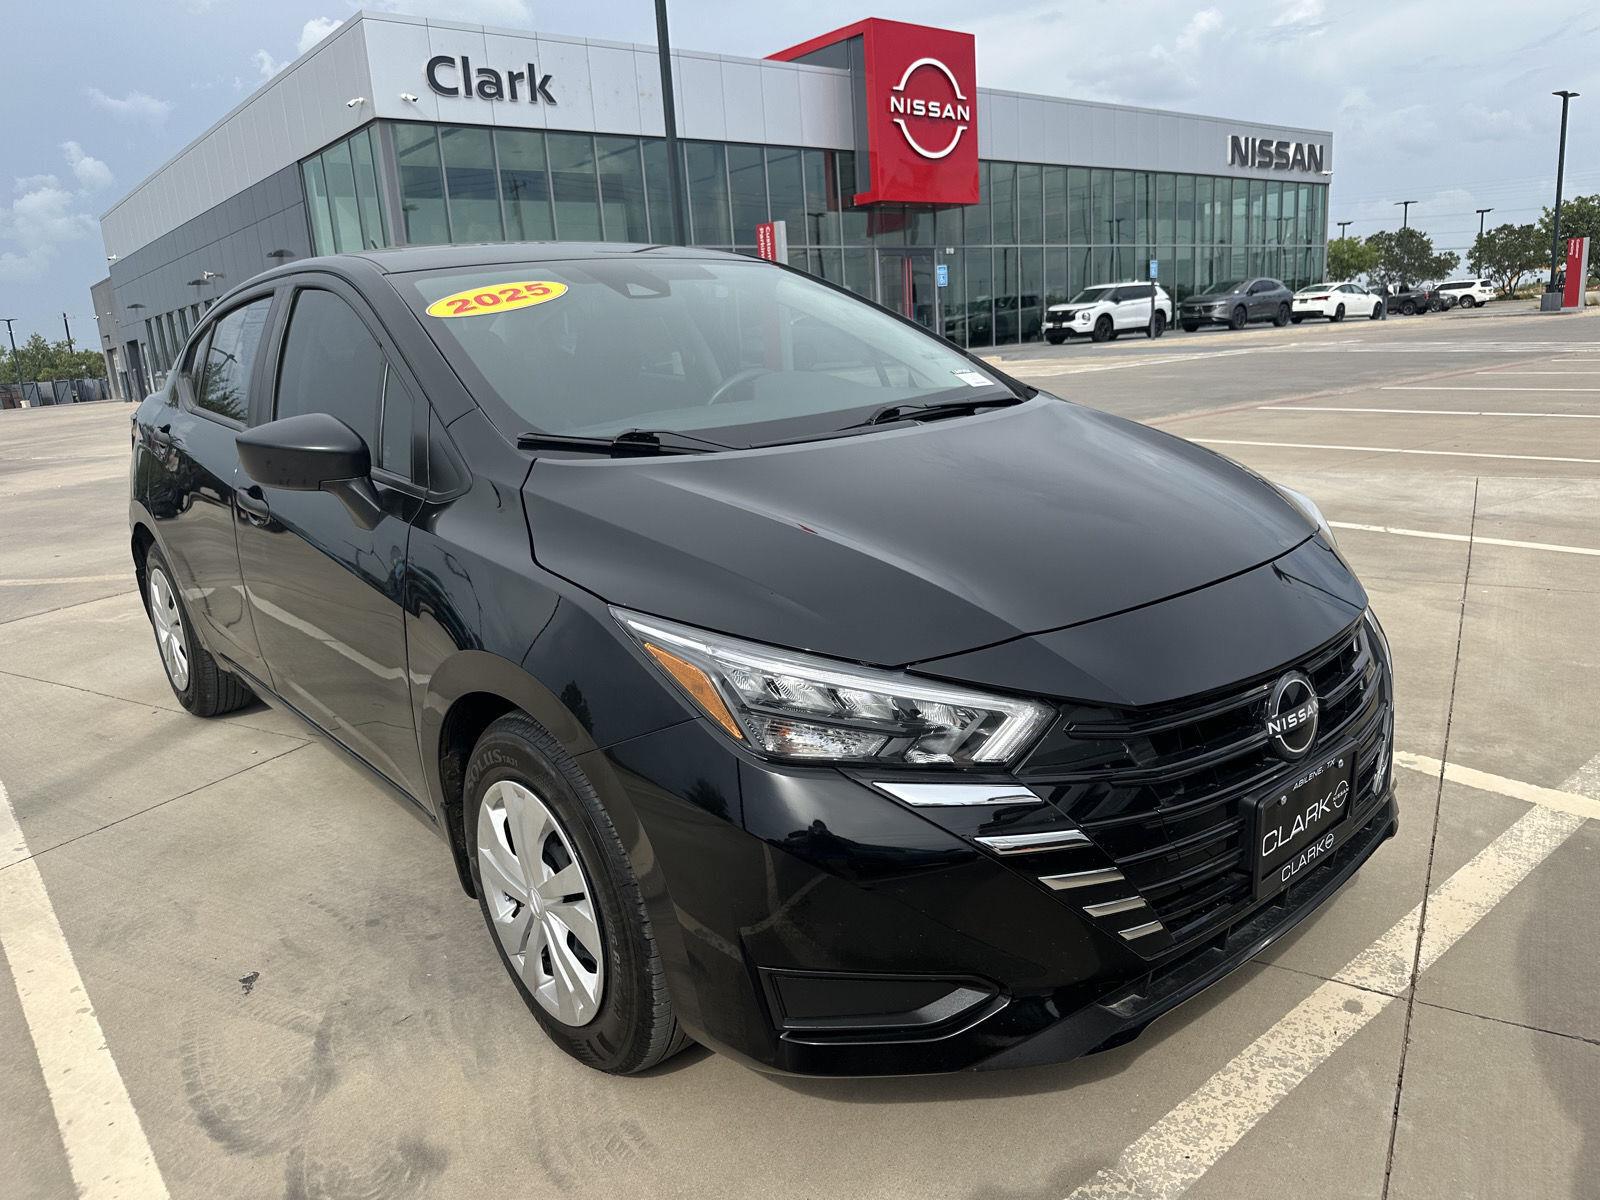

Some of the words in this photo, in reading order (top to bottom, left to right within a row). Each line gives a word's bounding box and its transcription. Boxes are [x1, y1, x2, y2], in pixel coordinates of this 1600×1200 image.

[426, 55, 557, 105] Clark
[890, 95, 969, 122] NISSAN
[1228, 134, 1323, 173] NISSAN
[446, 283, 552, 315] 2025
[1267, 700, 1319, 735] NISSAN
[1326, 758, 1336, 769] TX
[1262, 791, 1333, 857] CLARK
[1281, 838, 1325, 882] CLARK
